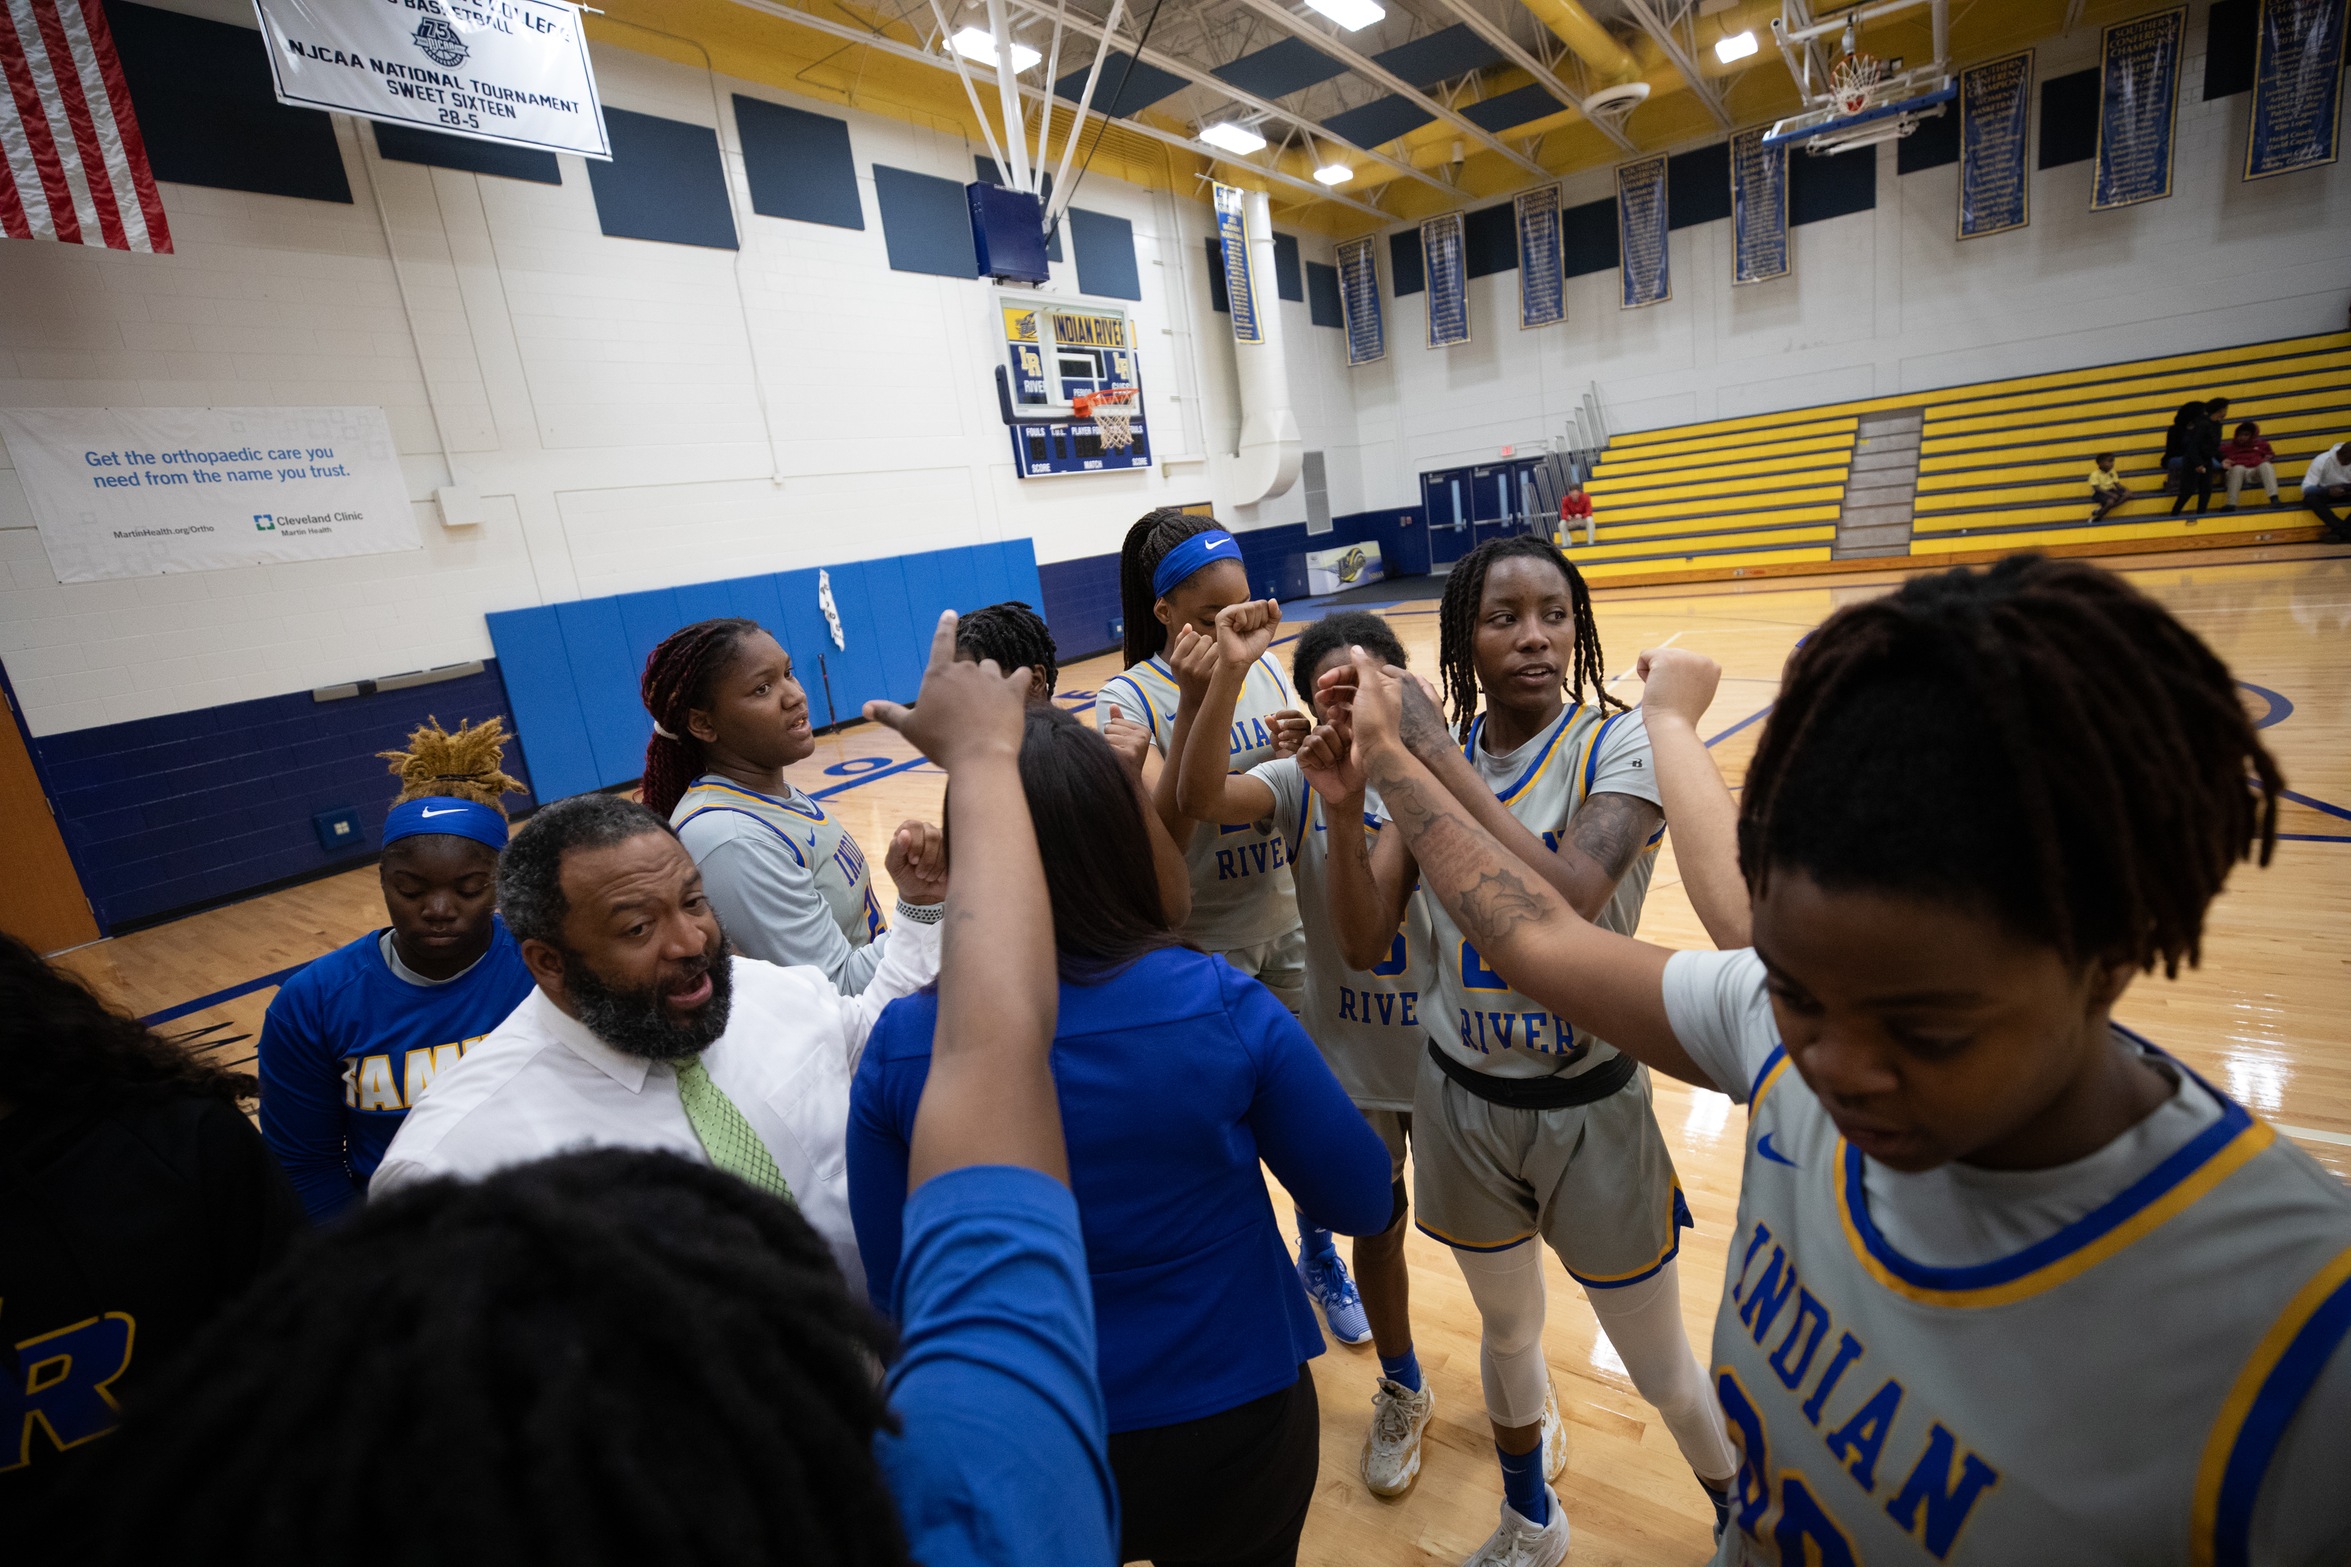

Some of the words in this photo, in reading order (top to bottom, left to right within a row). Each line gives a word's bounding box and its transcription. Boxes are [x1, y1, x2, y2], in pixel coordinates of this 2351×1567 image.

[423, 18, 450, 40] 75
[288, 39, 364, 69] NJCAA
[369, 58, 464, 91] NATIONAL
[470, 79, 579, 114] TOURNAMENT
[386, 79, 445, 104] SWEET
[451, 92, 517, 119] SIXTEEN
[438, 108, 479, 129] 28-5
[1053, 314, 1095, 343] INDIAN
[1024, 380, 1047, 394] RIVE
[1026, 427, 1046, 437] FOULS
[1071, 426, 1092, 436] PLAYER
[85, 451, 121, 467] Get
[124, 450, 156, 466] the
[161, 447, 263, 466] orthopaedic
[267, 448, 302, 461] care
[305, 447, 334, 462] you
[93, 471, 141, 488] need
[144, 470, 189, 486] from
[192, 469, 222, 483] the
[226, 469, 273, 482] name
[277, 468, 306, 482] you
[310, 464, 350, 478] trust.
[276, 513, 331, 526] Cleveland
[333, 511, 364, 522] Clinic
[113, 525, 215, 538] MartinHealth.org/Ortho
[281, 529, 307, 537] Martin
[308, 526, 332, 535] Health
[1215, 836, 1294, 881] RIVE
[1339, 986, 1420, 1027] RIVE
[1460, 1007, 1576, 1056] RIVER
[1732, 1221, 1999, 1563] INDIAN
